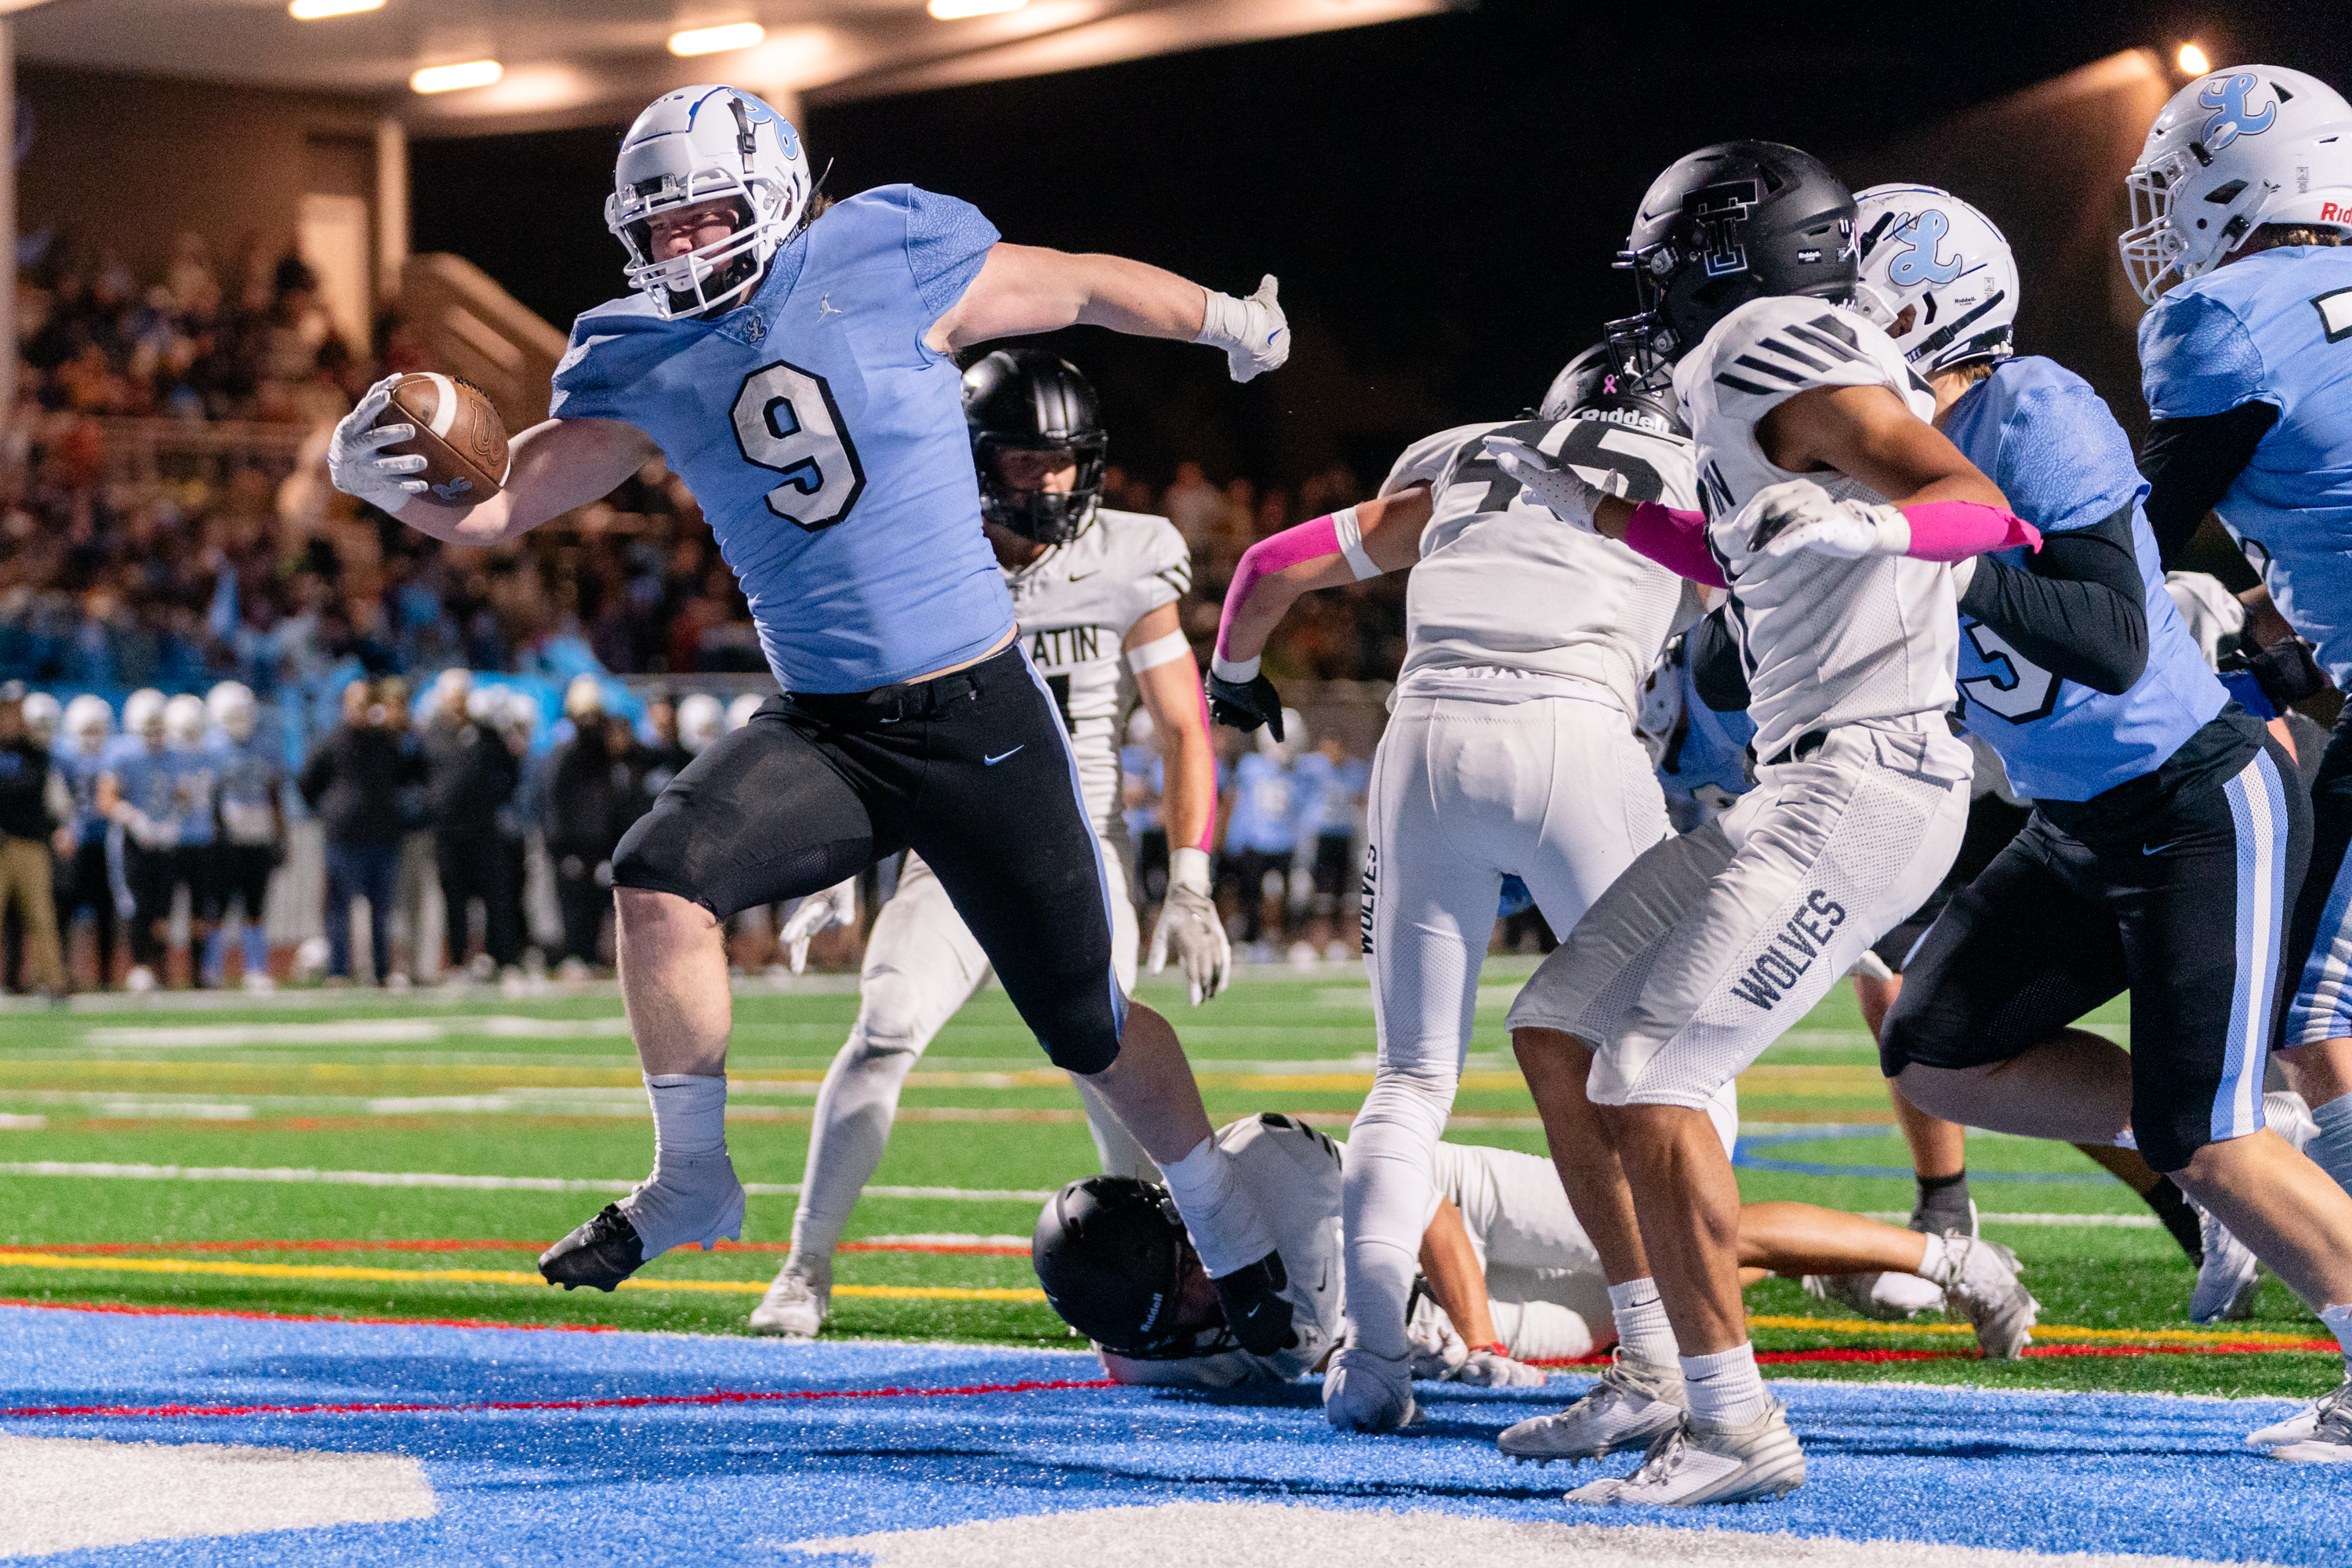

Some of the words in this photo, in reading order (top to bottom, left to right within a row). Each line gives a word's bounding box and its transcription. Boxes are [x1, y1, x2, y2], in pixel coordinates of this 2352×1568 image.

[728, 359, 867, 533] 9
[1582, 407, 1671, 434] Riddell
[1730, 889, 1846, 1011] WOLVES
